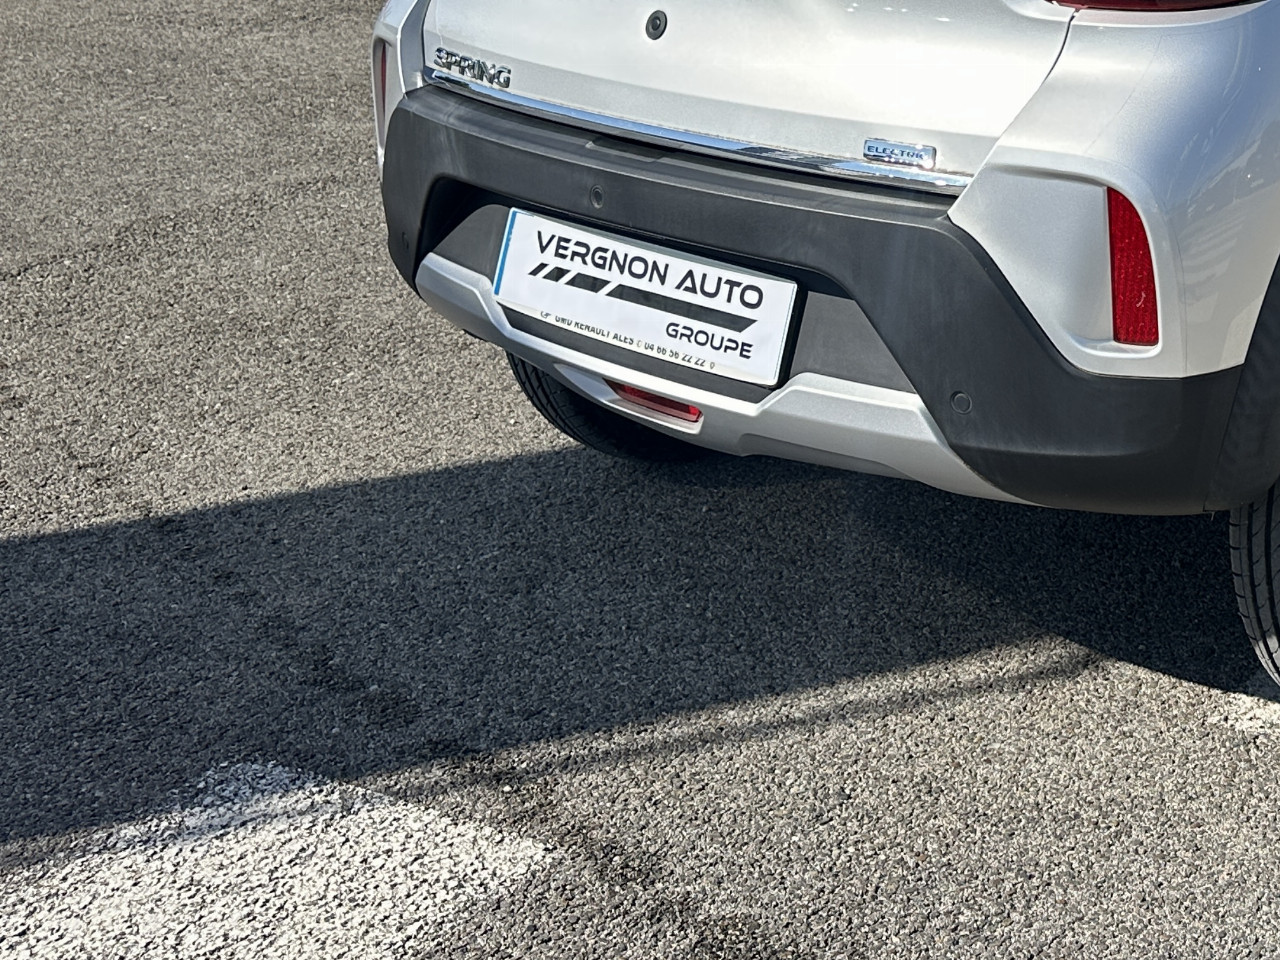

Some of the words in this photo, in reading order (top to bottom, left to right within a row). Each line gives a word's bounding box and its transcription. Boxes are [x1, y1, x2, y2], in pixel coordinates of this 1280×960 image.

[433, 46, 513, 89] SPRING
[537, 230, 669, 286] VERGNON
[674, 269, 764, 310] AUTO
[665, 322, 754, 360] GROUPE
